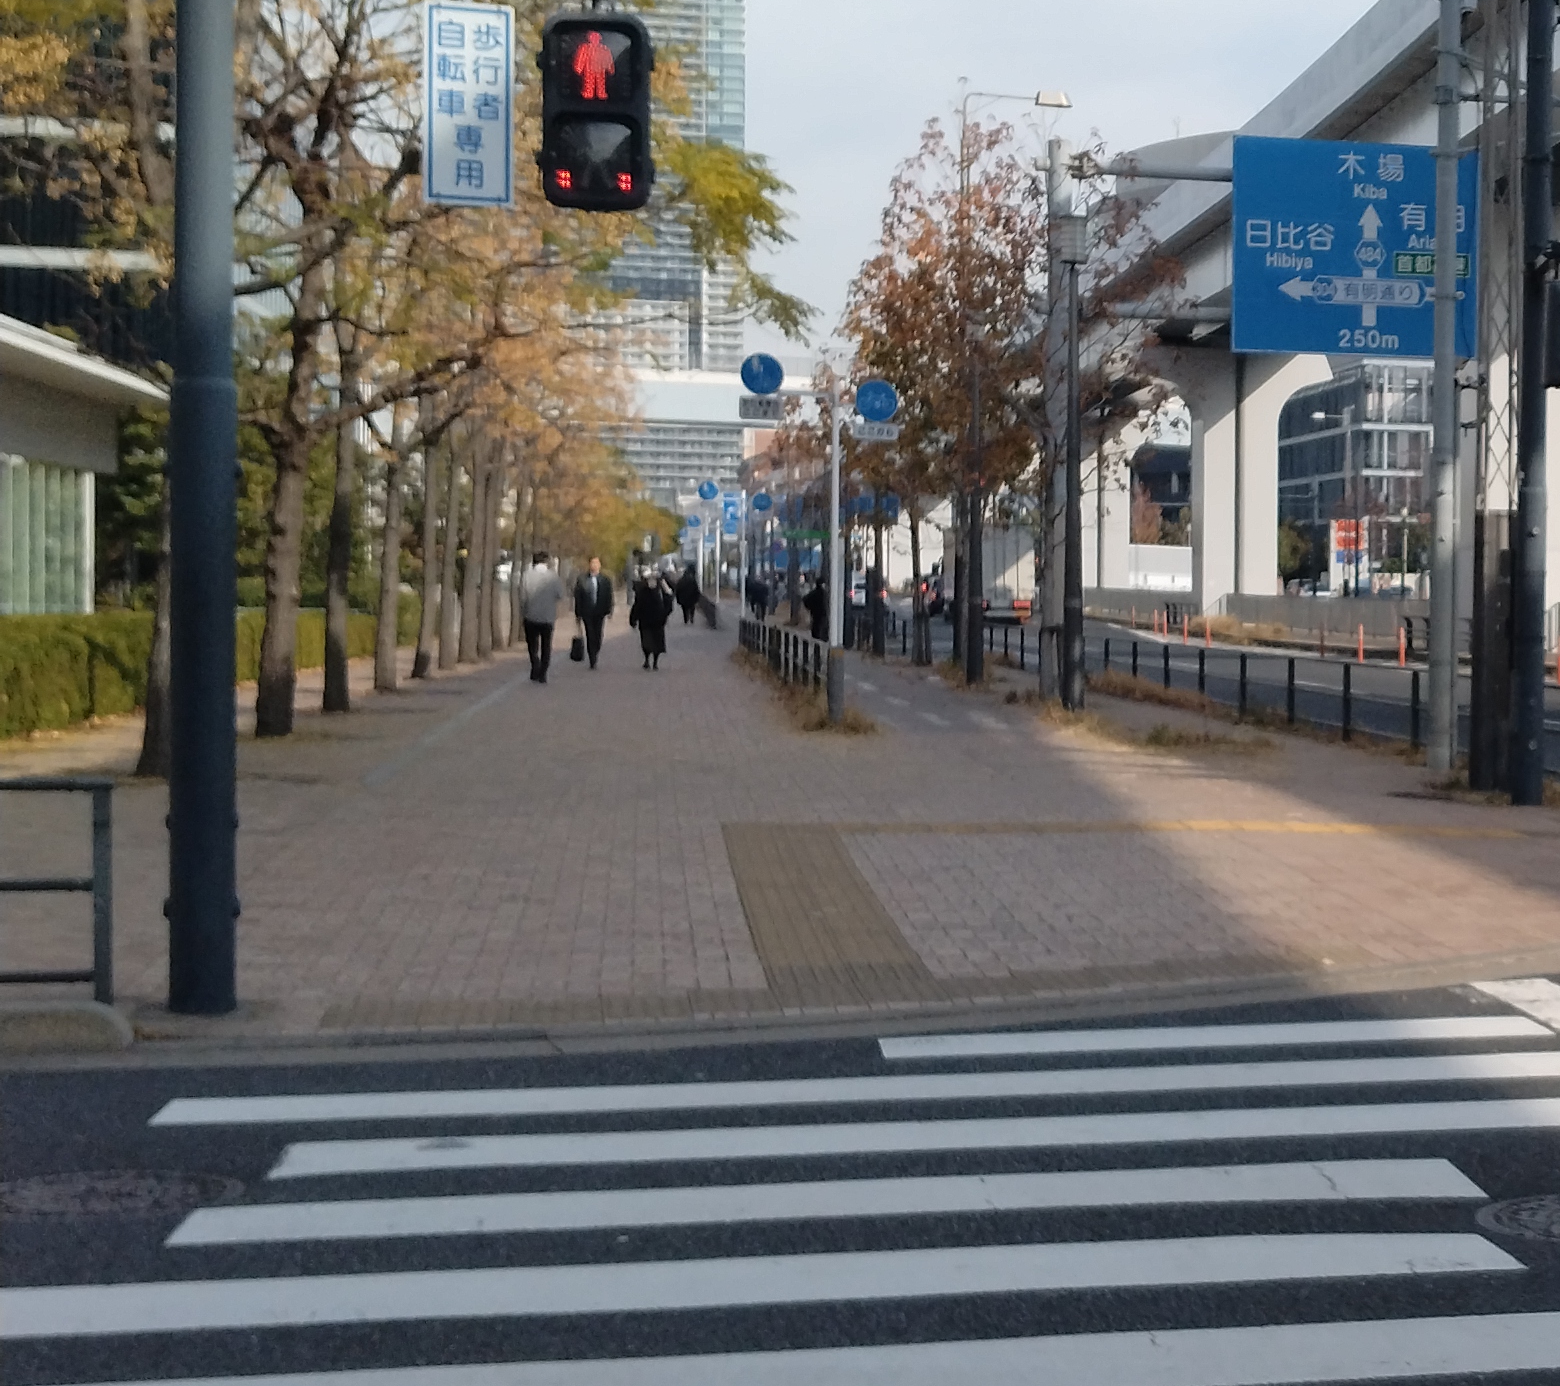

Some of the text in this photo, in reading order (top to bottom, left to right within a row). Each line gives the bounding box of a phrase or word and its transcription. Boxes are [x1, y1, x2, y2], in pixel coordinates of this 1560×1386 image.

[437, 18, 467, 118] 自転車
[472, 21, 504, 121] 歩行者
[453, 124, 485, 189] 専用
[1337, 150, 1405, 182] 木場
[1353, 183, 1388, 200] Kiba
[1245, 218, 1335, 252] 日比谷
[1265, 251, 1314, 272] Hibiya
[1357, 245, 1382, 263] 484
[1343, 281, 1414, 301] 有明通り
[1338, 328, 1400, 350] 250m
